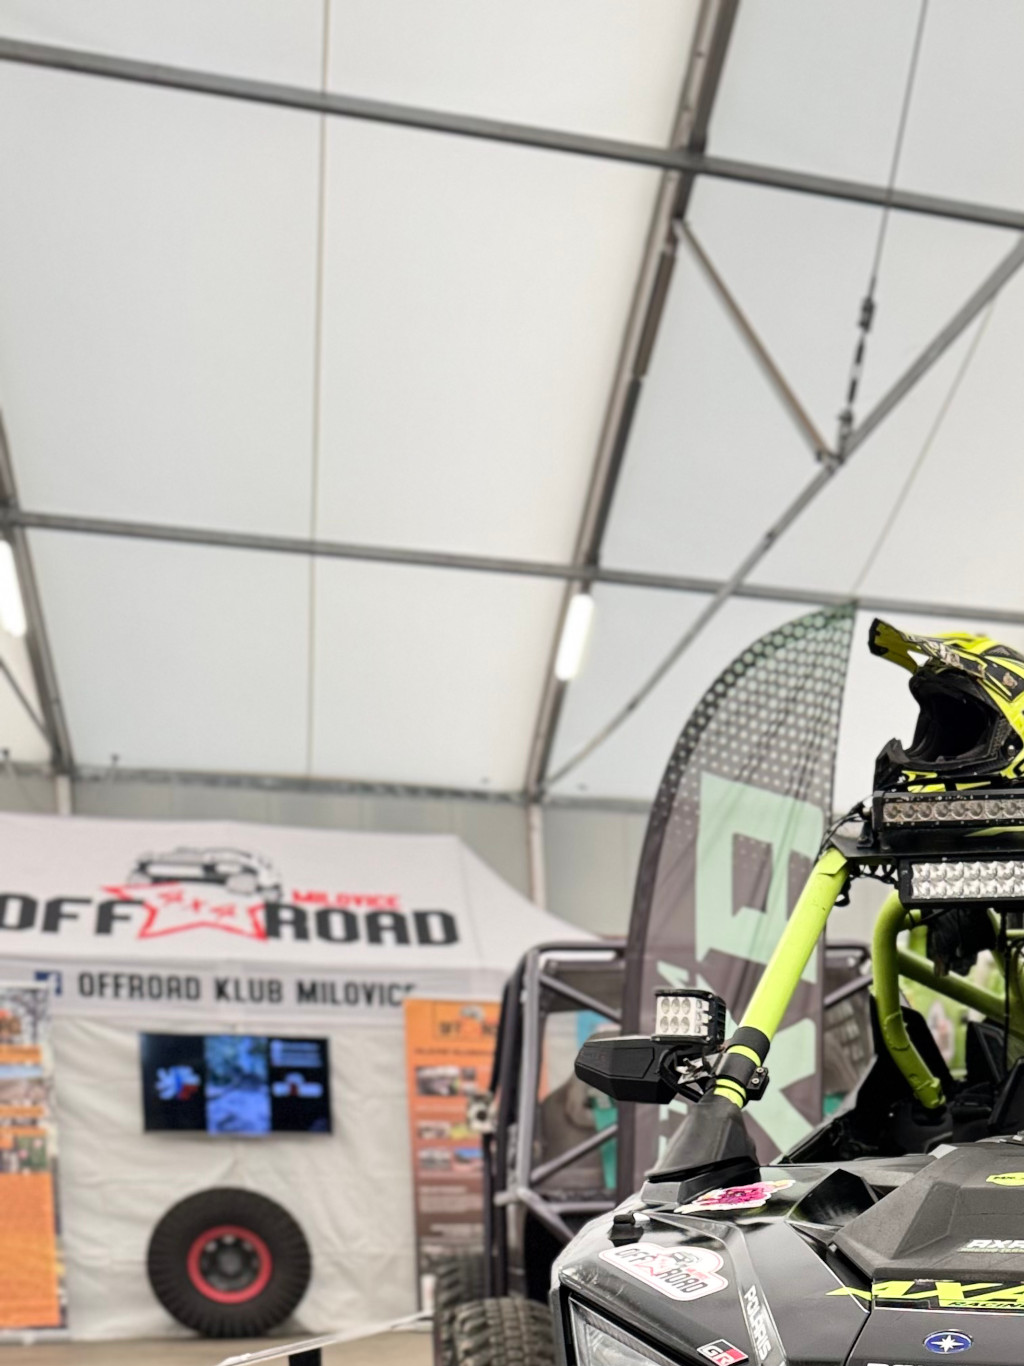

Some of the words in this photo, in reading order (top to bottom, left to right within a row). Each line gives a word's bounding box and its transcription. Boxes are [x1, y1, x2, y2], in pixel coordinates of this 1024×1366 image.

[264, 900, 460, 945] ROAD
[78, 972, 201, 999] OFFROAD
[213, 977, 284, 1003] KLUB
[614, 1247, 657, 1264] OFF
[655, 1268, 709, 1294] ROAD
[743, 1285, 772, 1361] POLARIS
